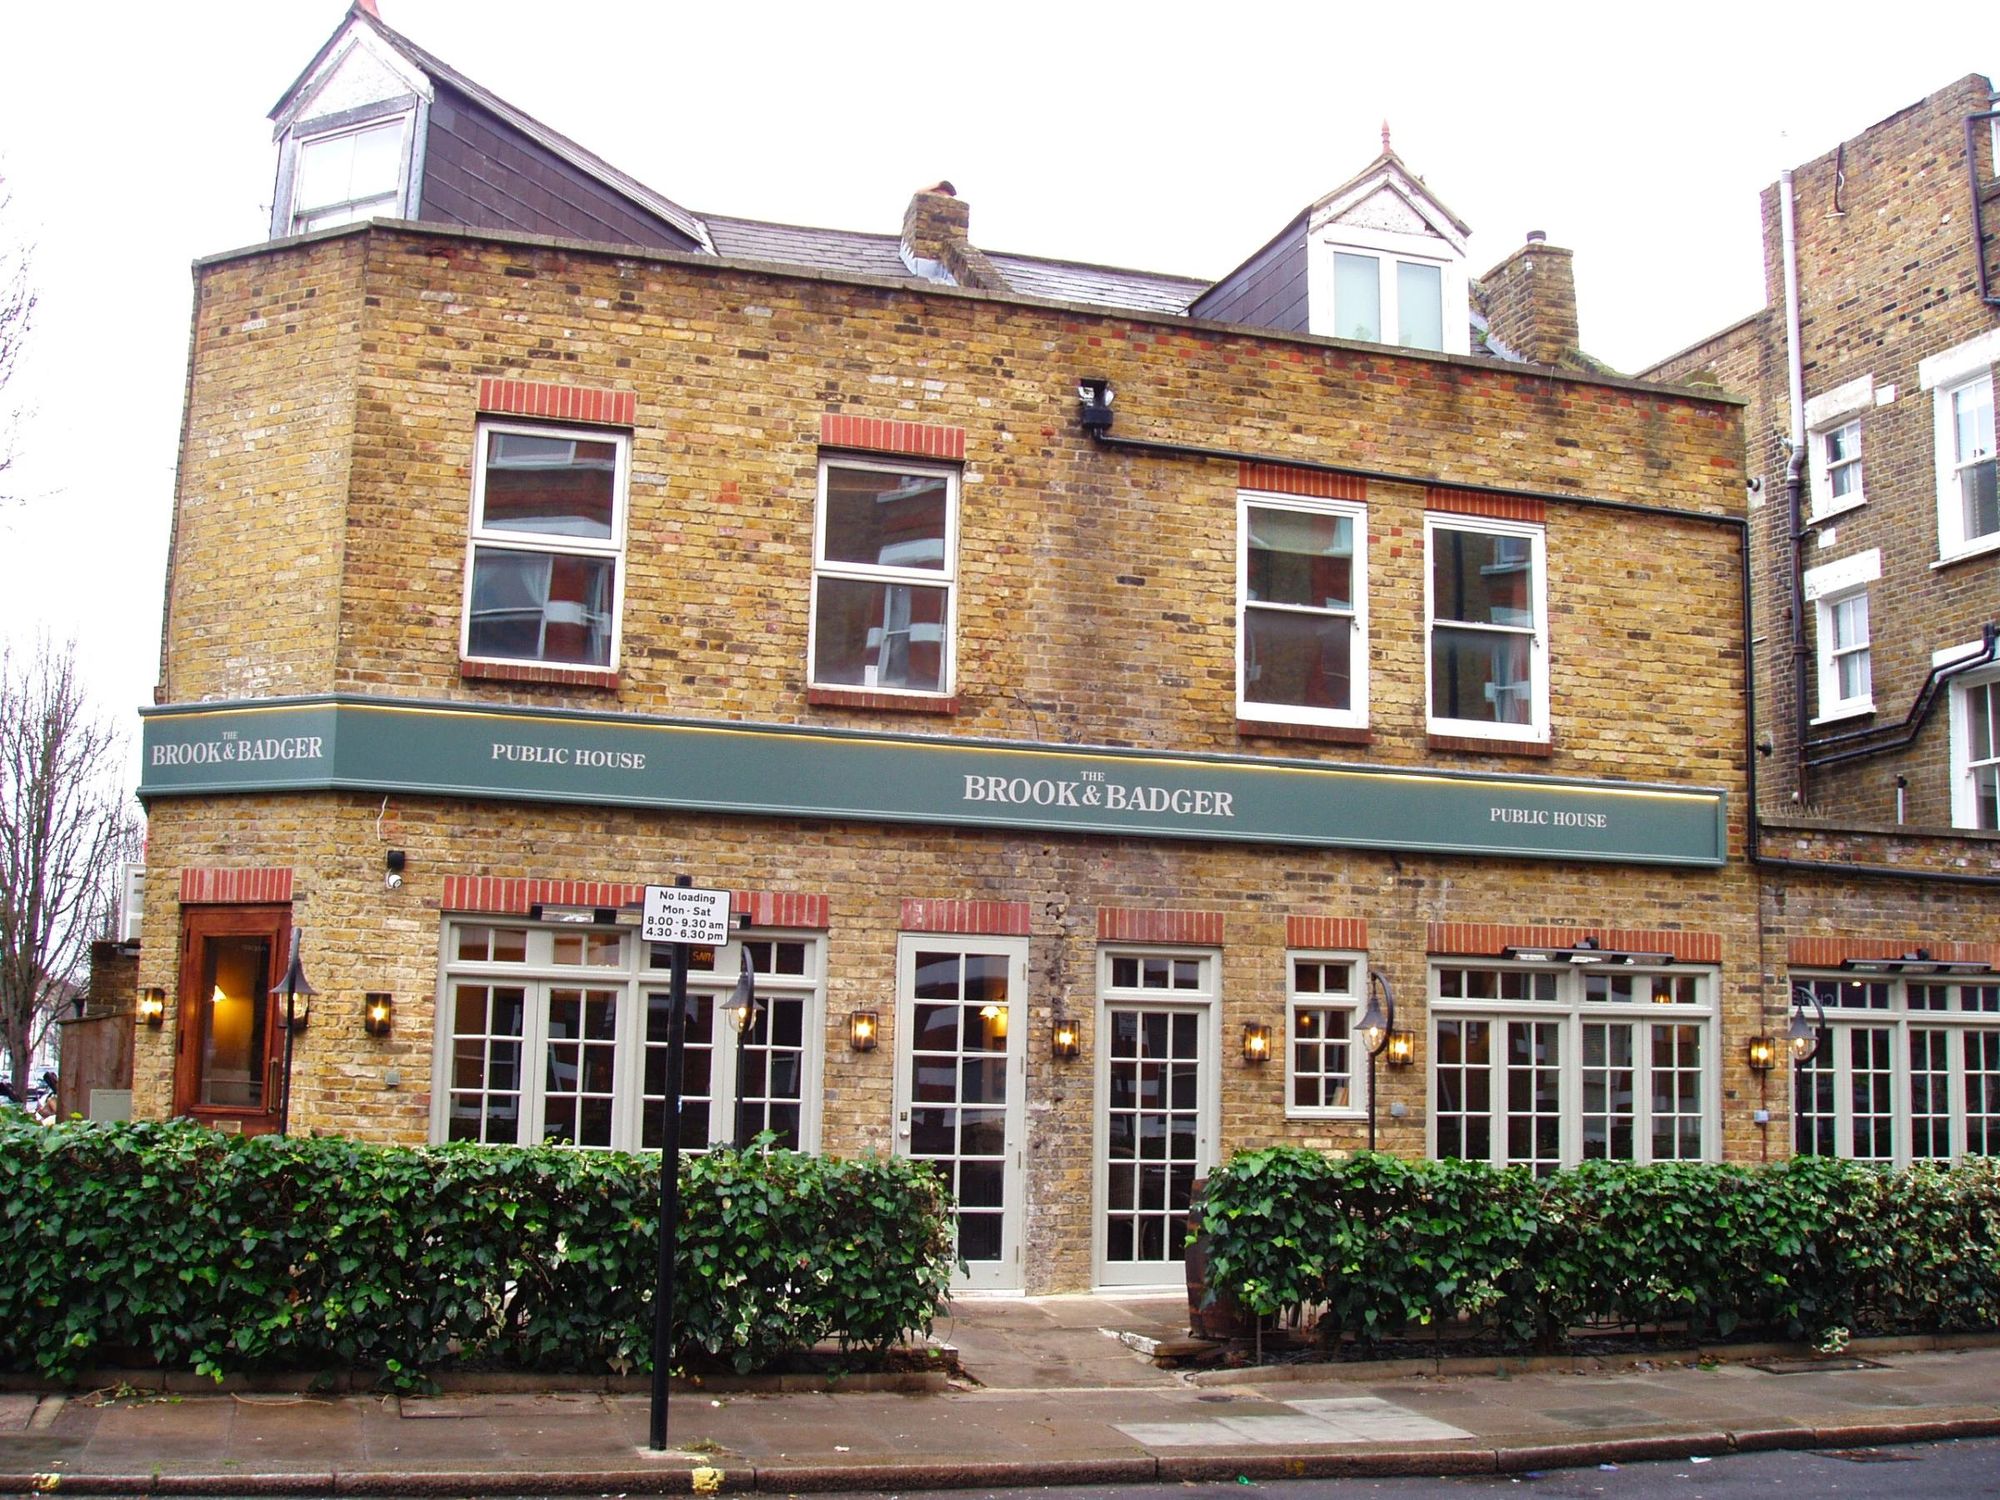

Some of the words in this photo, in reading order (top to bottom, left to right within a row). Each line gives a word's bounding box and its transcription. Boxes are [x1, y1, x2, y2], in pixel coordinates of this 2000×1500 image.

[222, 731, 238, 740] THE
[491, 743, 569, 765] PUBLIC
[574, 749, 646, 770] HOUSE
[1080, 770, 1105, 782] THE
[1490, 807, 1549, 825] PUBLIC
[1553, 811, 1607, 828] HOUSE
[659, 890, 675, 900] No
[678, 892, 716, 905] loading
[662, 904, 685, 915] Mon
[693, 906, 711, 917] Sat
[647, 916, 674, 926] 8.00
[681, 918, 707, 928] 9.30
[708, 922, 724, 930] am
[646, 927, 672, 937] 4.30
[680, 929, 706, 939] 6.30
[707, 933, 724, 941] pm
